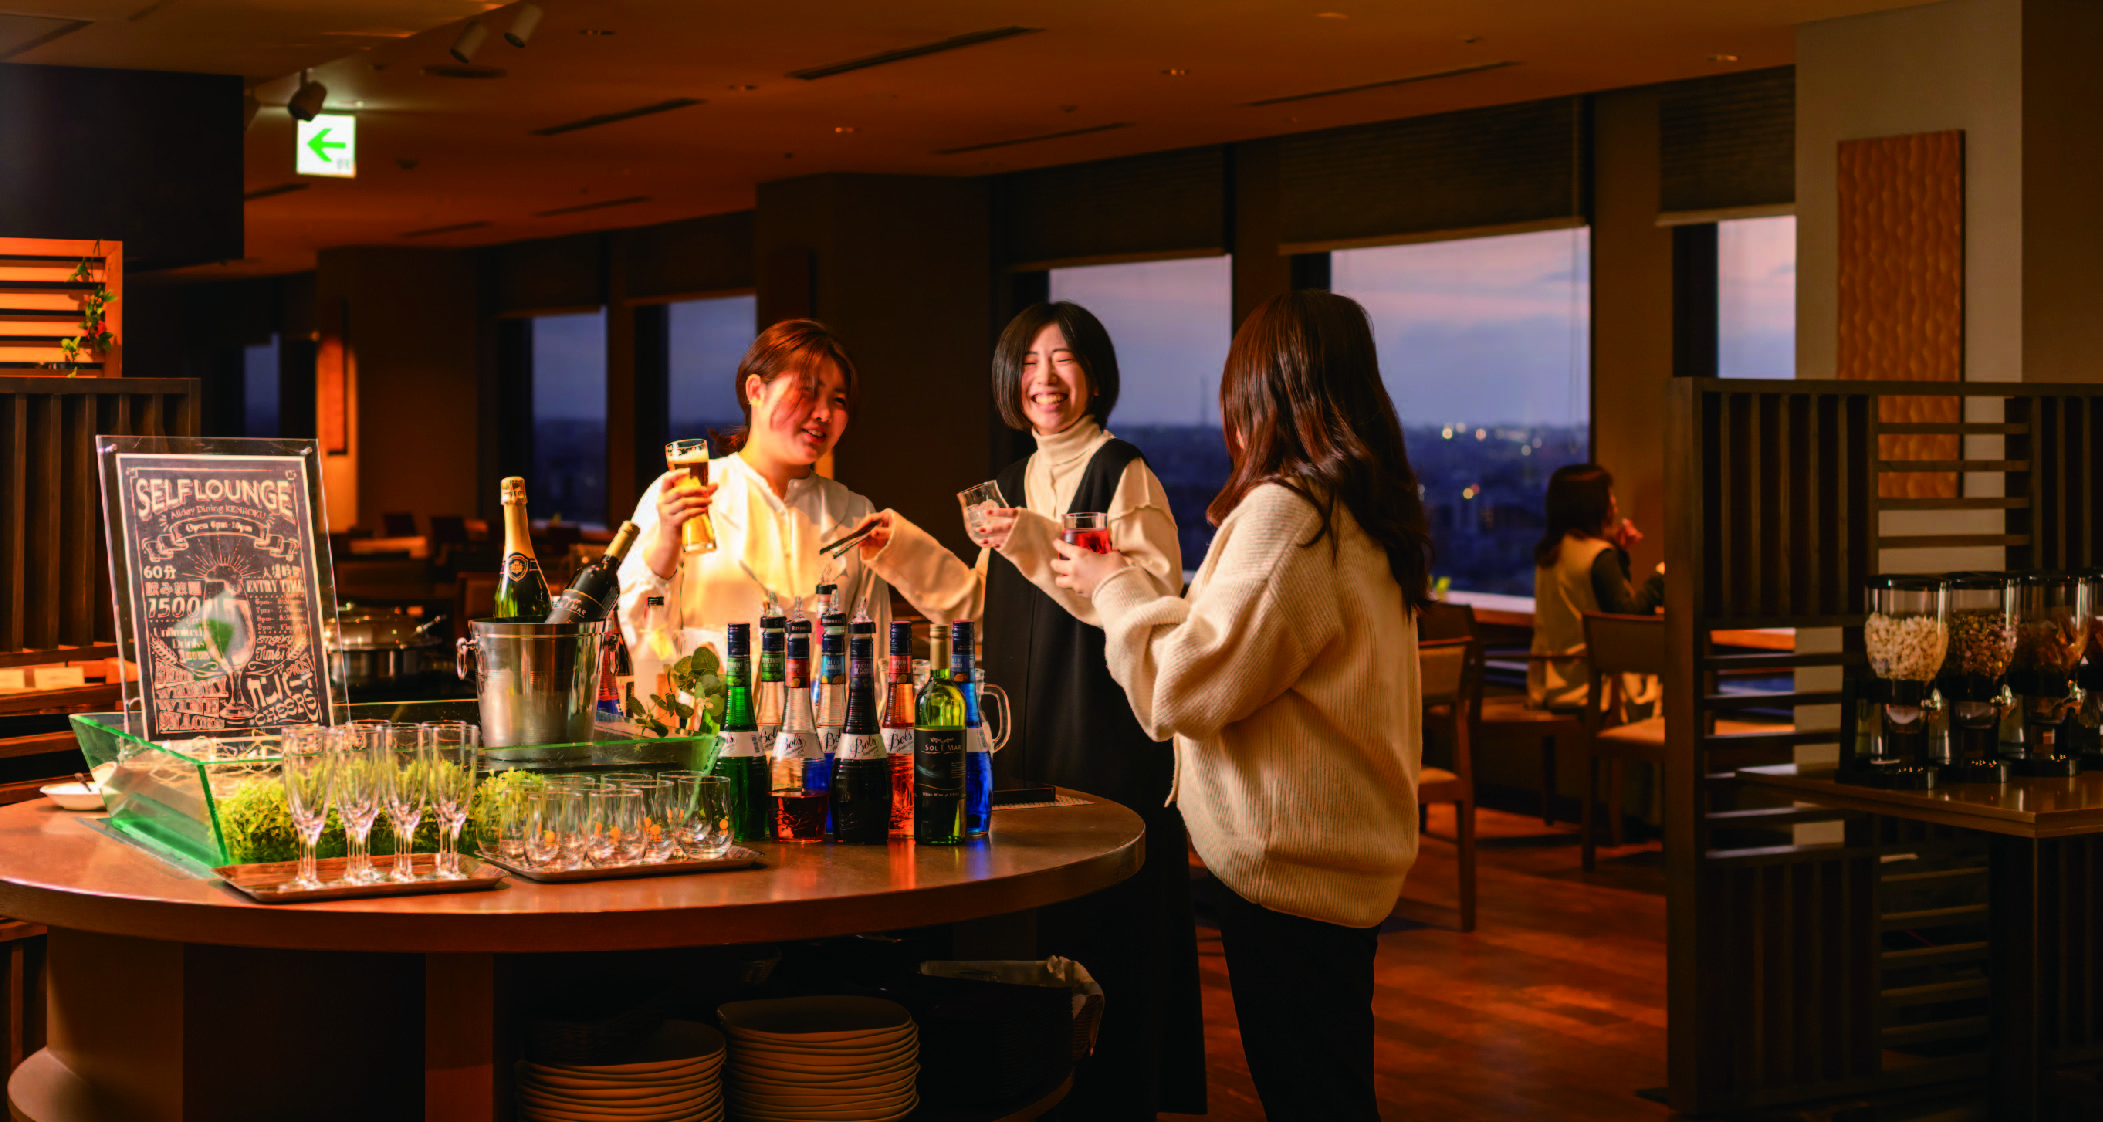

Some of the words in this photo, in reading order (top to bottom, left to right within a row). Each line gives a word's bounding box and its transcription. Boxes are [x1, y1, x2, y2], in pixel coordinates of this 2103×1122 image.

[136, 478, 193, 521] SELF
[193, 478, 297, 525] LOUNGE
[196, 504, 224, 514] Dining
[225, 504, 267, 520] KENROKU
[185, 522, 209, 533] Open
[143, 565, 176, 579] 60分
[246, 579, 278, 593] ENTRY
[254, 688, 319, 727] CHEERS
[850, 736, 877, 758] Bols
[890, 729, 913, 751] Bols
[925, 744, 939, 752] SOL
